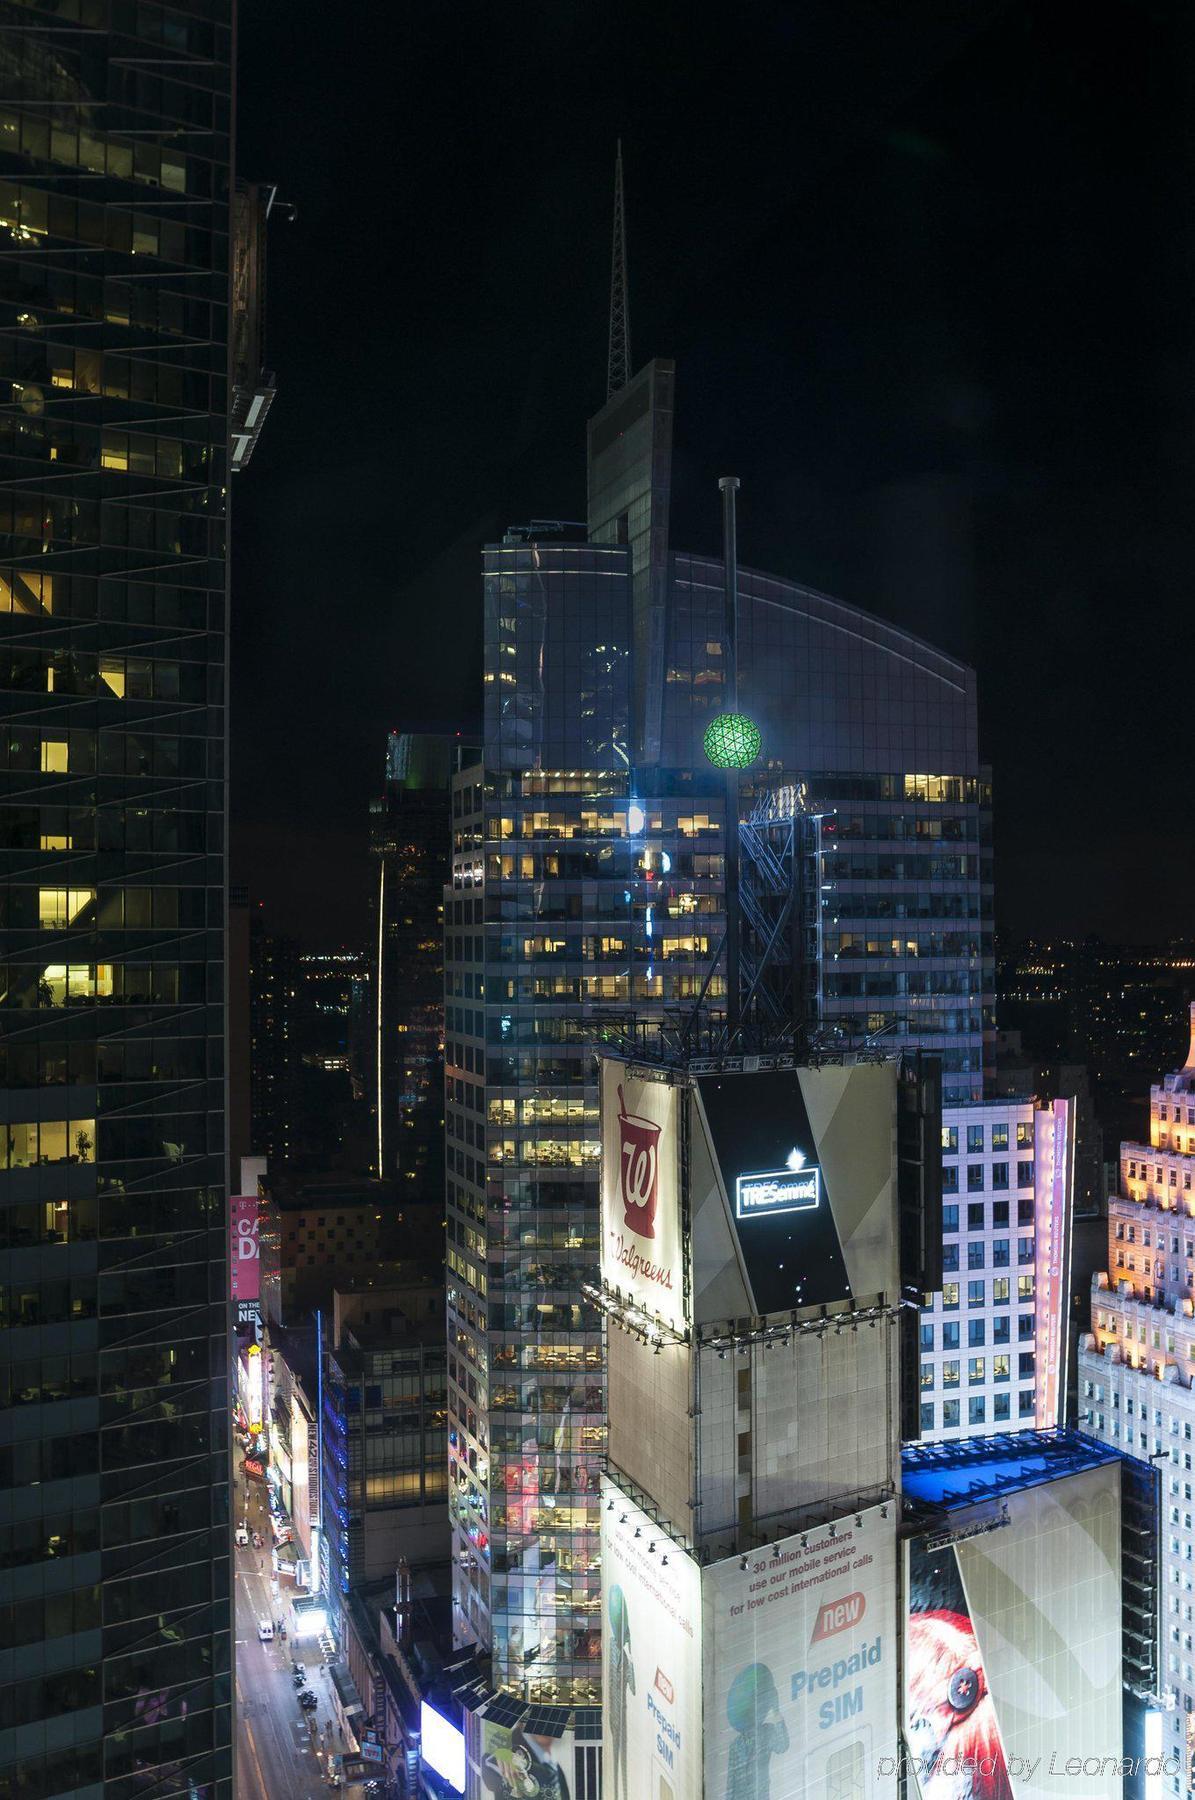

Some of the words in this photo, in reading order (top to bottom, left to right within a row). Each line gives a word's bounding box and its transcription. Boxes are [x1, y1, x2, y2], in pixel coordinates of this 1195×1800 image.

[623, 1141, 655, 1207] W
[611, 1231, 672, 1290] Walgreens
[238, 1302, 248, 1310] ON
[749, 1579, 767, 1593] use
[770, 1572, 787, 1584] our
[789, 1558, 821, 1580] mobile
[823, 1545, 857, 1565] service
[752, 1561, 767, 1575] 30
[769, 1550, 801, 1569] million
[804, 1531, 853, 1555] customers
[730, 1602, 745, 1616] for
[747, 1596, 765, 1610] low
[767, 1586, 788, 1602] cost
[791, 1562, 850, 1594] international
[852, 1553, 873, 1569] calls
[823, 1597, 860, 1633] new
[791, 1635, 882, 1702] Prepaid
[647, 1692, 681, 1750] Prepaid
[819, 1685, 864, 1730] SIM
[657, 1733, 674, 1770] SIM
